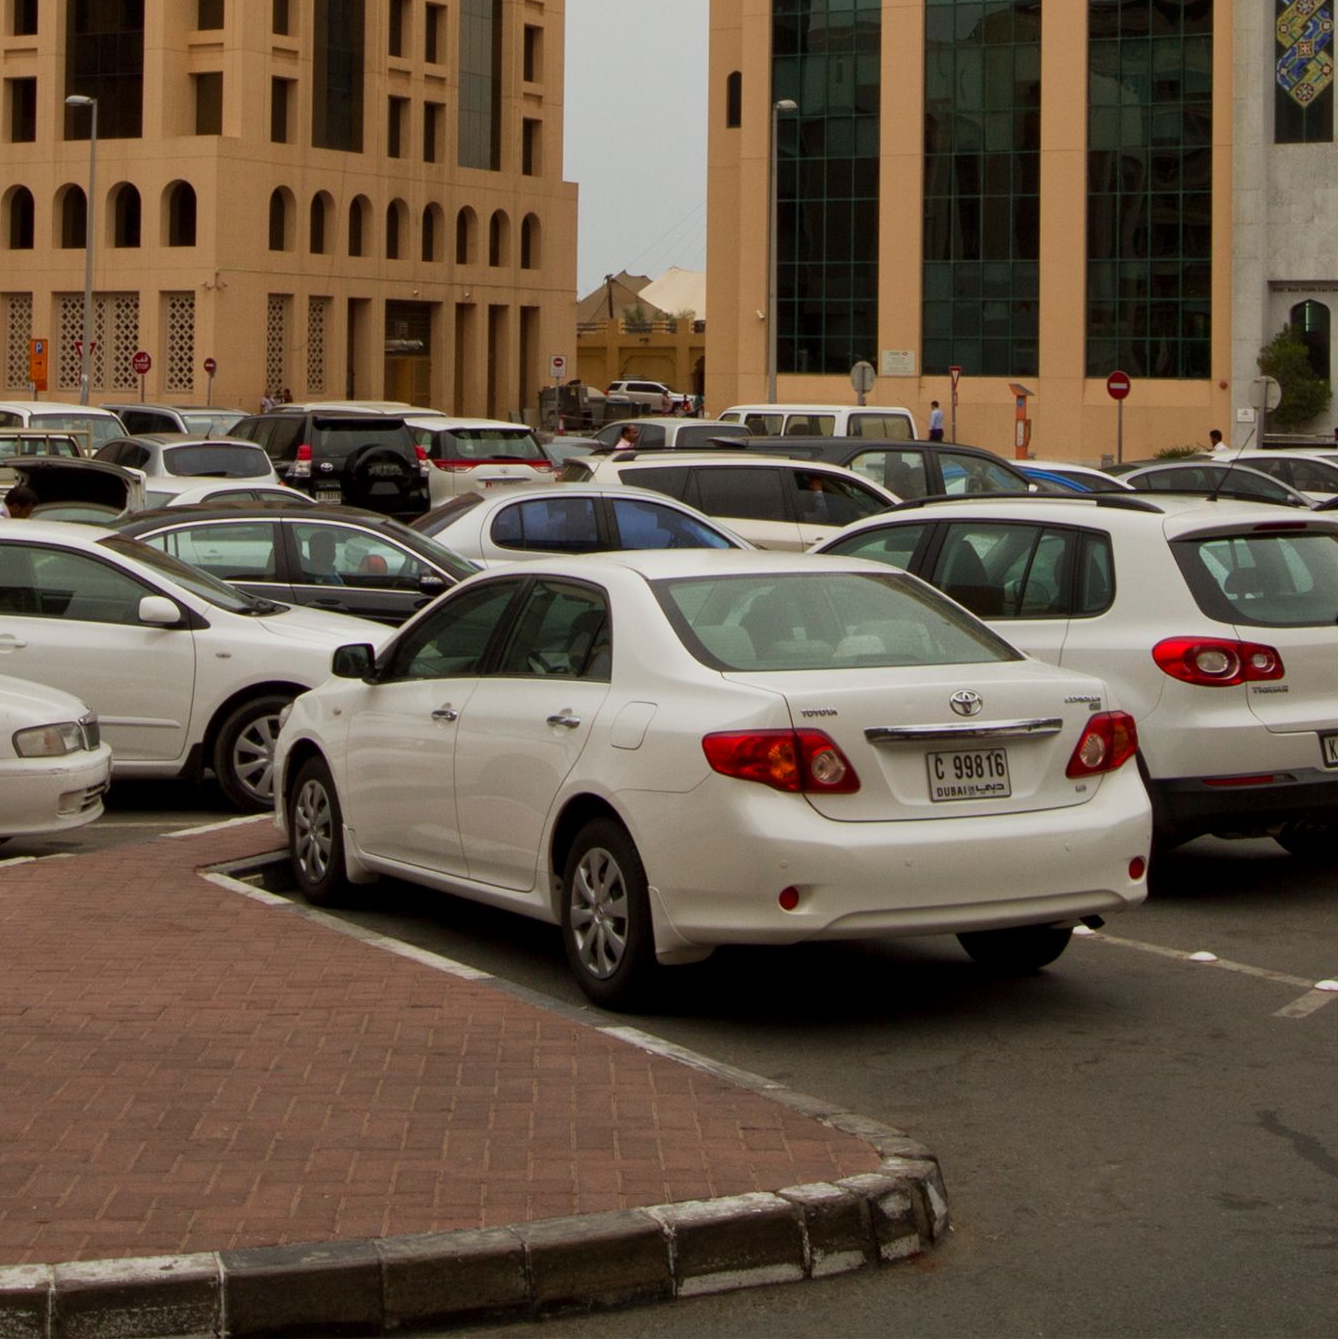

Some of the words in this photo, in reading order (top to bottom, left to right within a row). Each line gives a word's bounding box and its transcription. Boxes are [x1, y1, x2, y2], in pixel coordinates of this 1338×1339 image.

[801, 708, 838, 718] TOYOTA
[1328, 739, 1338, 761] K
[935, 756, 945, 780] C
[953, 752, 1005, 780] 99816
[936, 785, 967, 798] DUBAI
